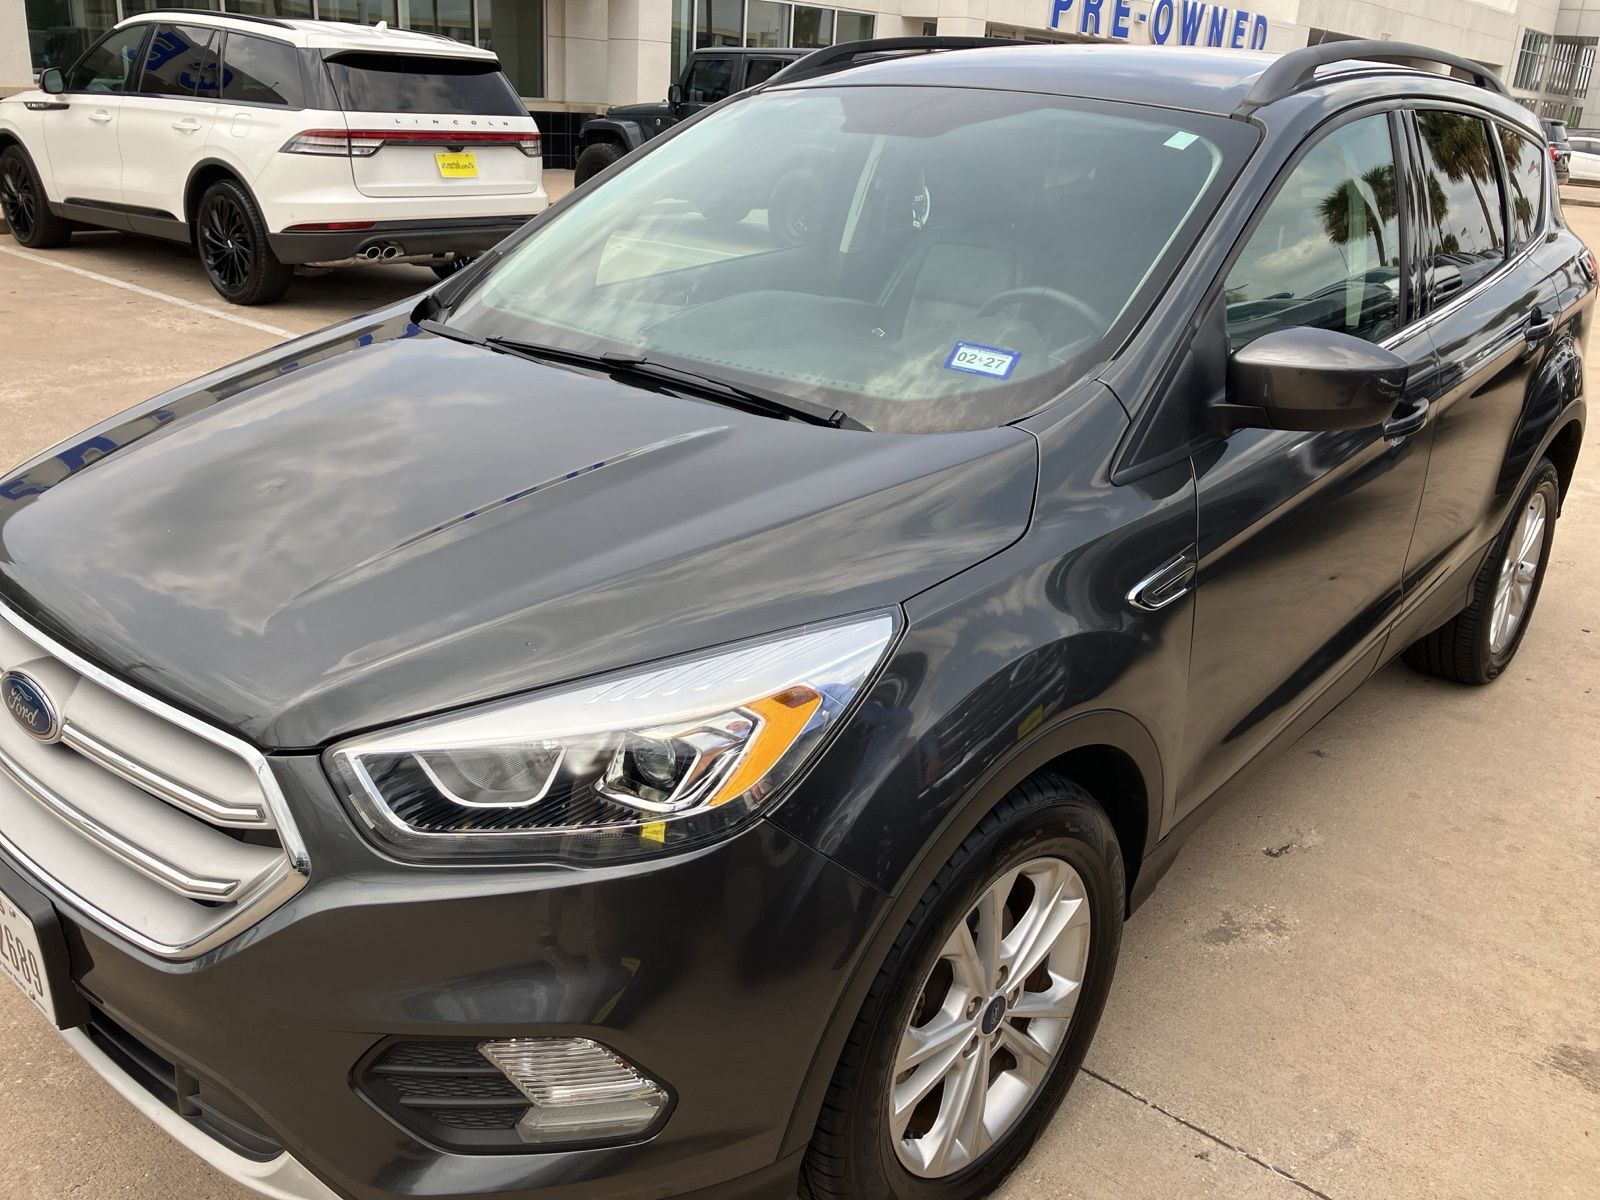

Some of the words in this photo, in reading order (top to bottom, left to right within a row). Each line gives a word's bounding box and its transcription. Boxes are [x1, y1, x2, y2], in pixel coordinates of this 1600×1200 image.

[1051, 0, 1268, 50] PRE-OWNED
[395, 118, 509, 127] LINCOLN
[957, 351, 978, 364] 02
[983, 357, 1006, 369] 27
[7, 684, 39, 727] Ford
